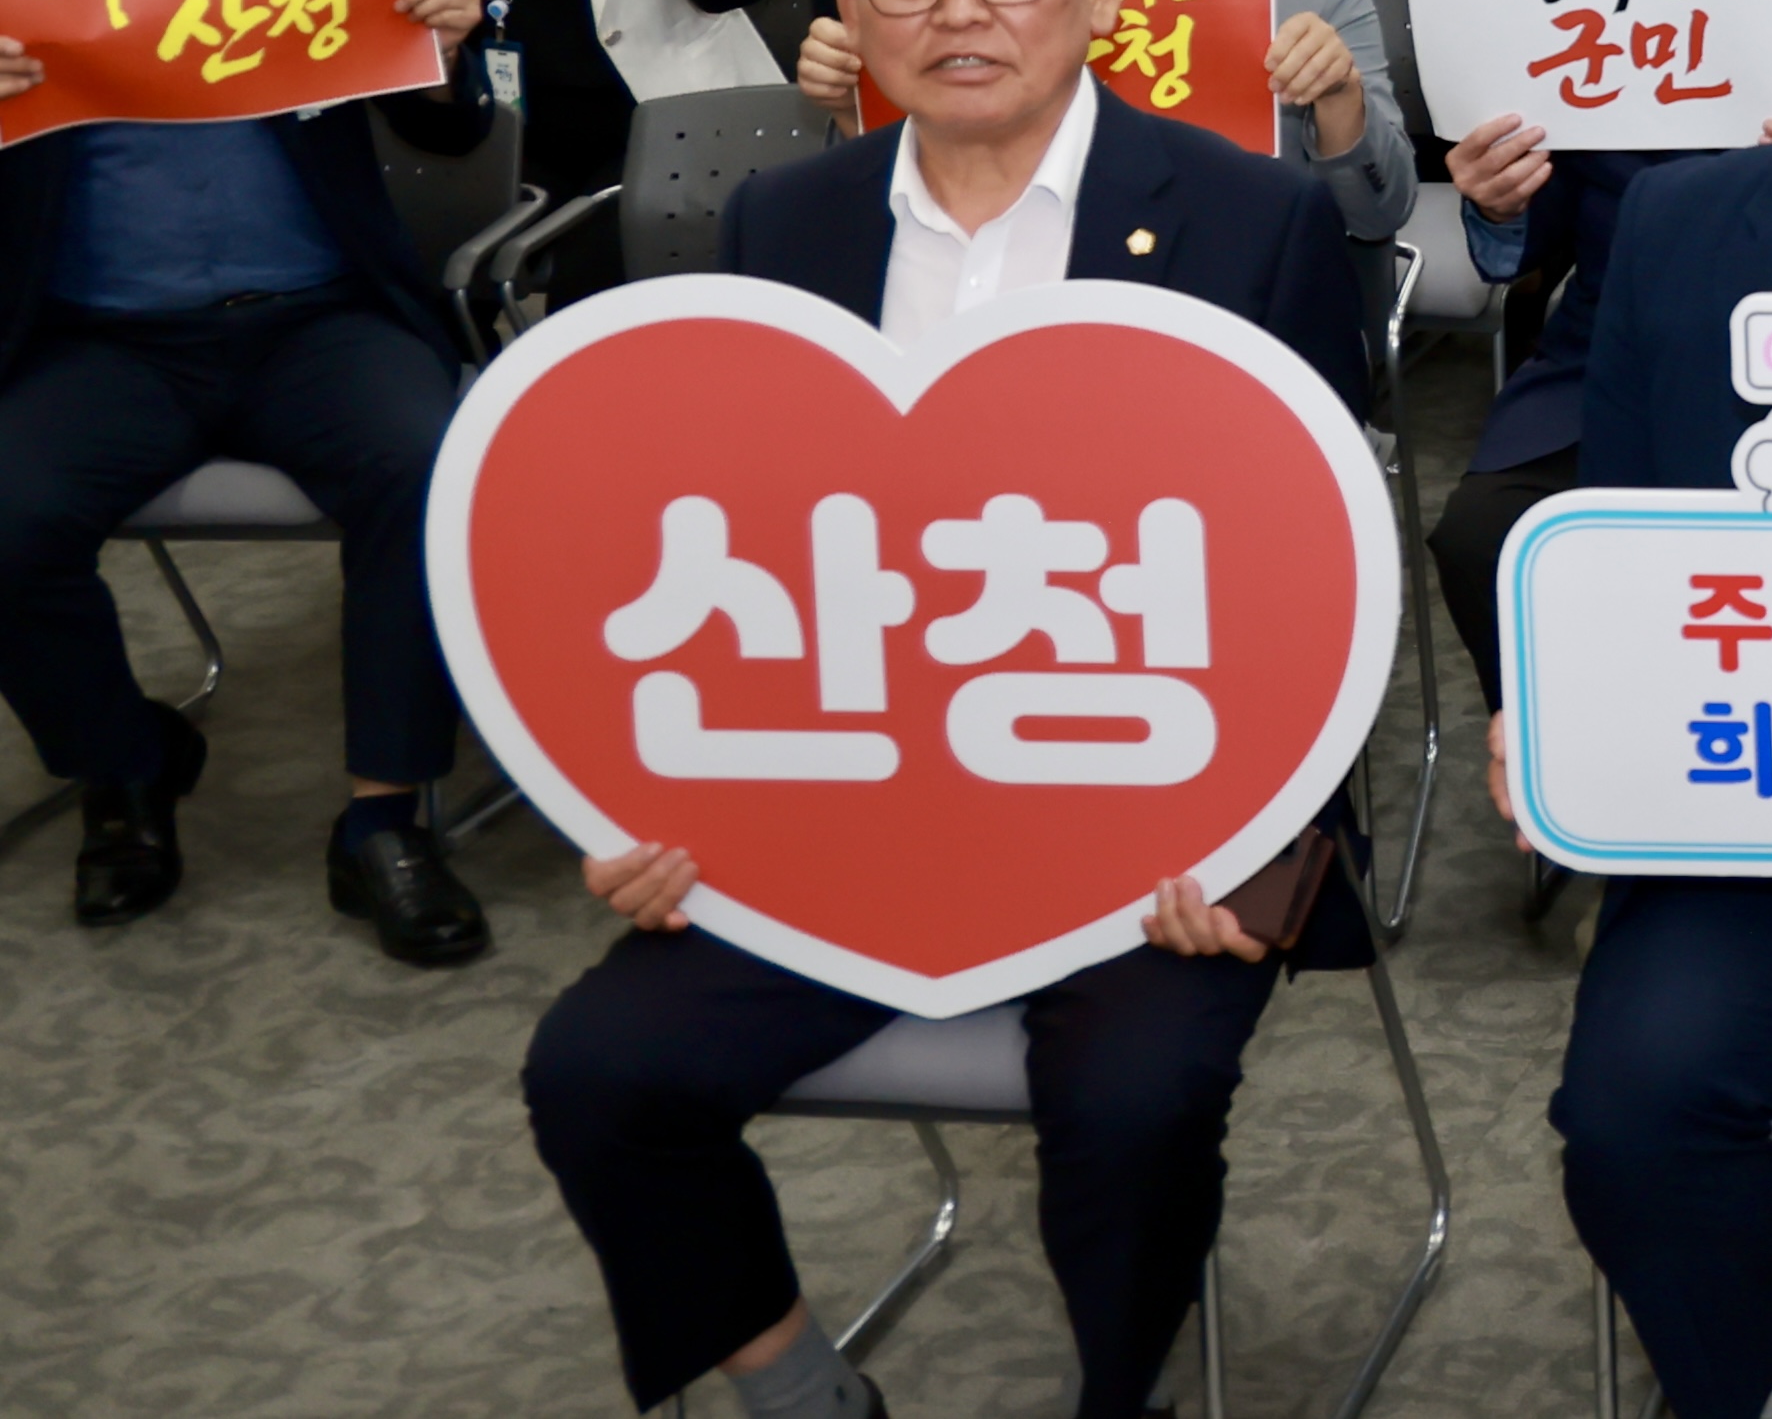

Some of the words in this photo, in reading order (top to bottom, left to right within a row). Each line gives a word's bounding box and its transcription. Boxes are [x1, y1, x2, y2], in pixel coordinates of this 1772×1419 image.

[1086, 10, 1197, 109] 청
[1526, 8, 1733, 109] 군민
[603, 492, 1218, 787] 산청
